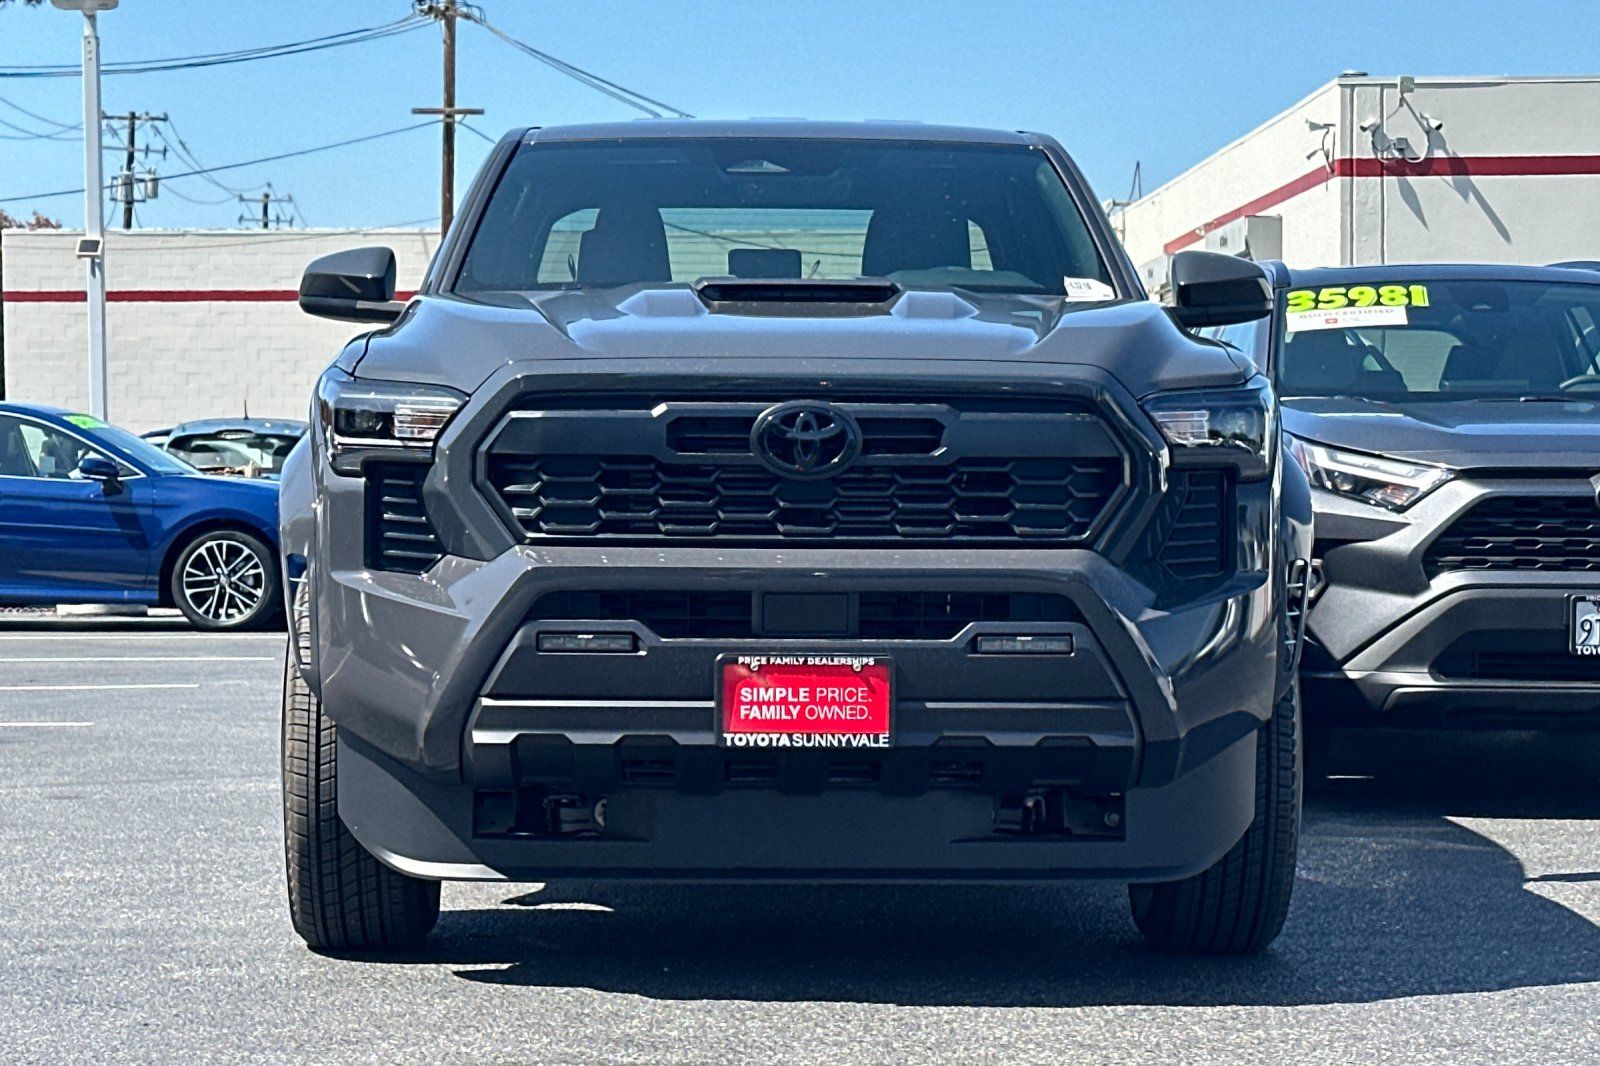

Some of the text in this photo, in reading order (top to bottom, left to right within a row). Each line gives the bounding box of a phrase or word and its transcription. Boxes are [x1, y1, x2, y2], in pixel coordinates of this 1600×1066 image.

[1286, 284, 1430, 313] 35981
[1580, 619, 1600, 645] 9
[738, 656, 875, 666] PRICE FAMILY DEALERSHIPS
[740, 687, 872, 703] SIMPLE PRICE.
[740, 705, 872, 720] FAMILY OWNED.
[723, 733, 890, 747] TOYOTA SUNNYVALE
